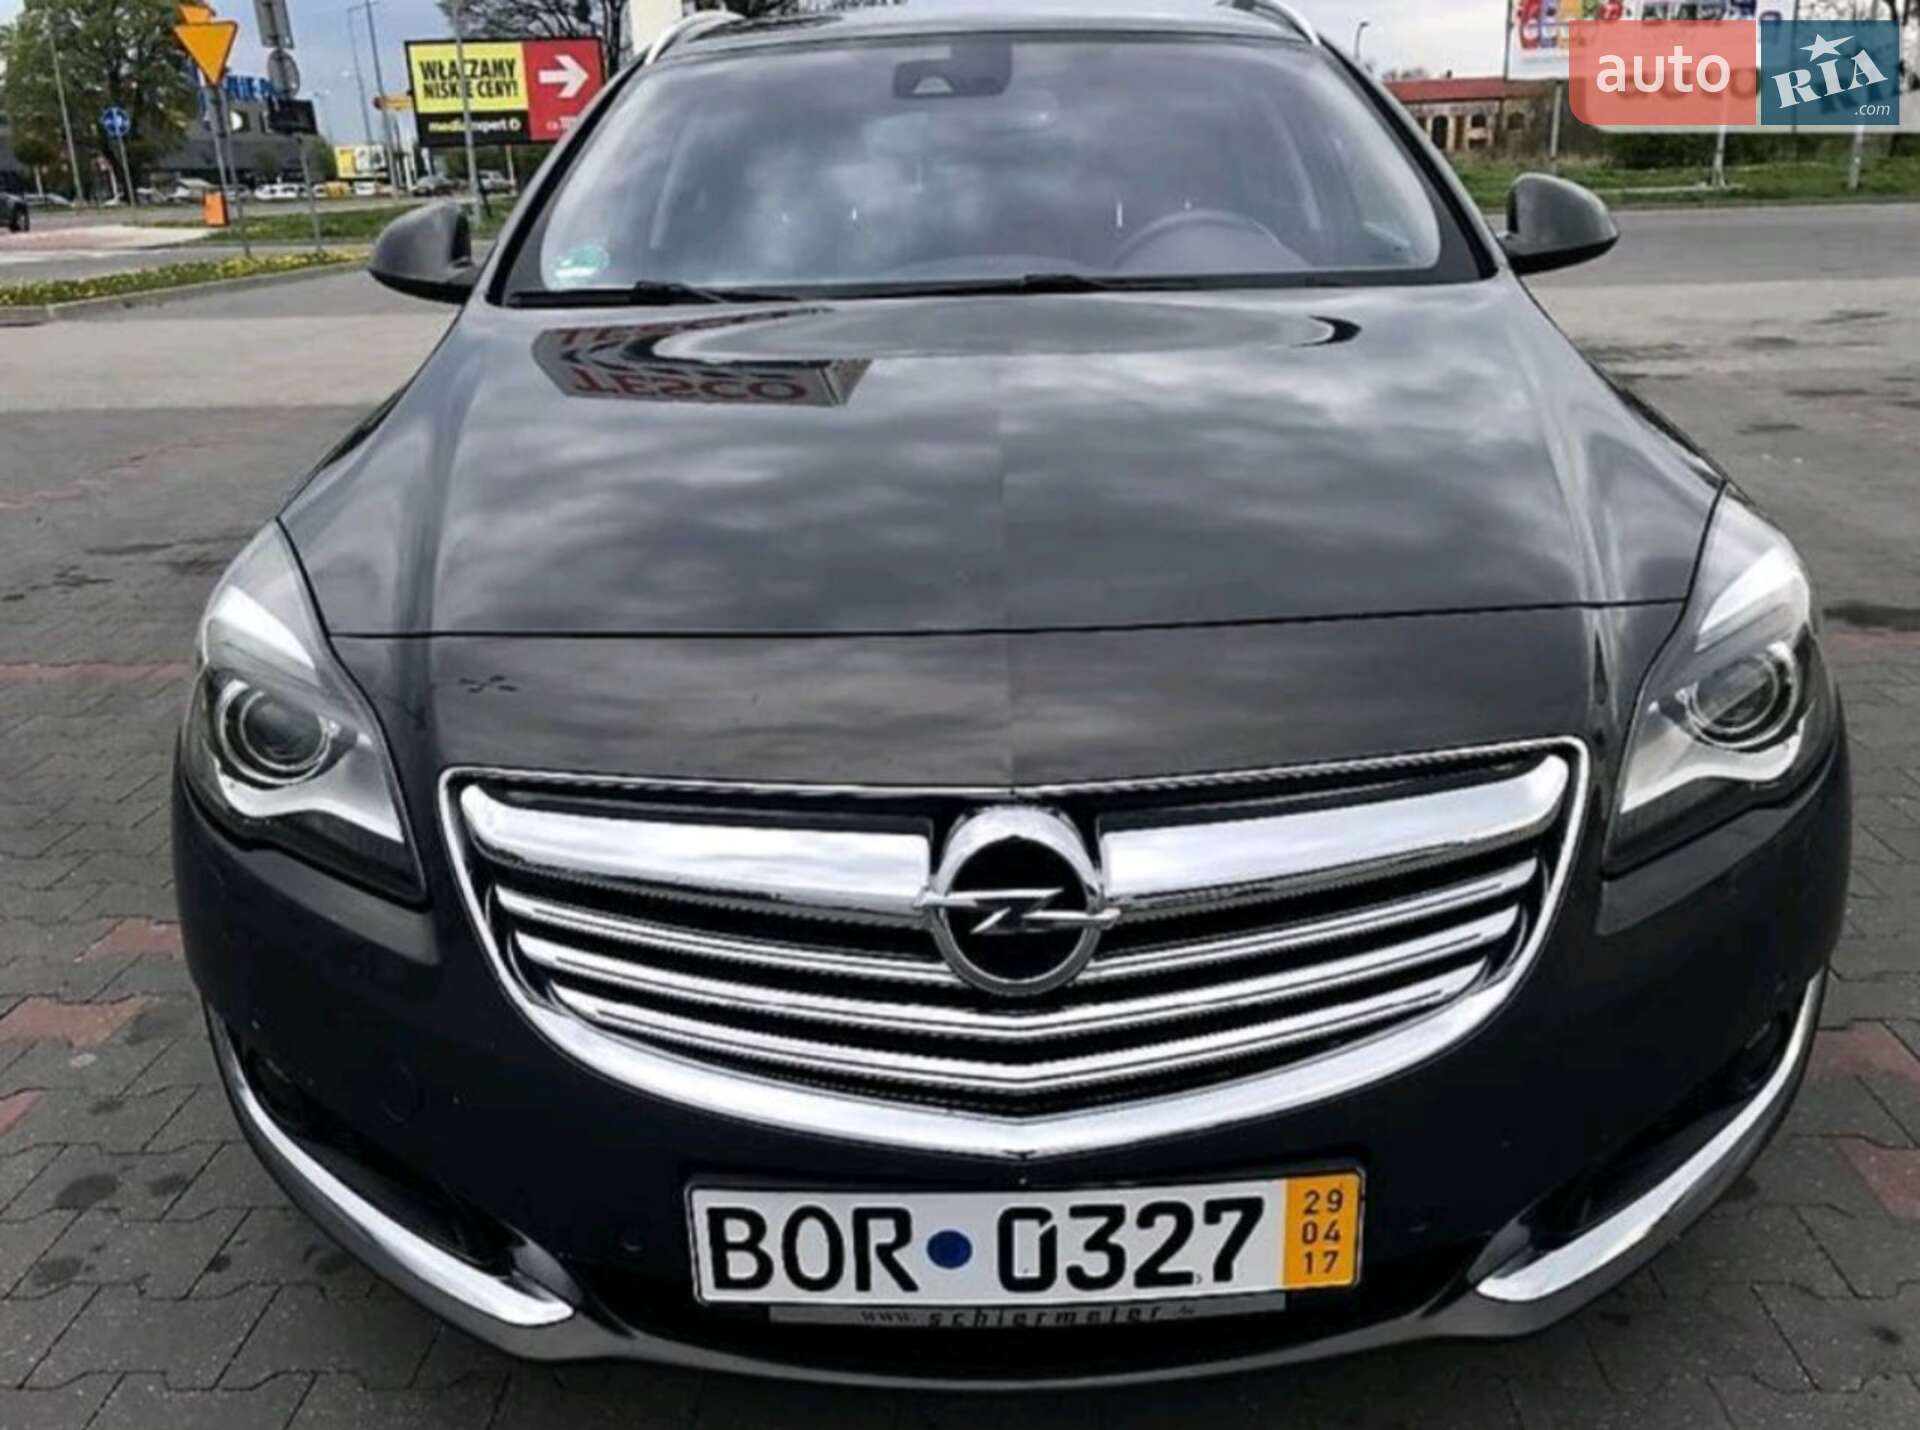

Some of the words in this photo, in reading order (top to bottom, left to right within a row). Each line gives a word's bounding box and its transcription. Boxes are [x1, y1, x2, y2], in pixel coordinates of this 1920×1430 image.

[423, 81, 473, 99] NISKE
[428, 117, 508, 133] mediaxpert
[1303, 1189, 1344, 1216] 29
[706, 1204, 919, 1292] BOR
[997, 1196, 1264, 1293] 0327
[1302, 1221, 1342, 1245] 04
[1304, 1250, 1341, 1275] 17
